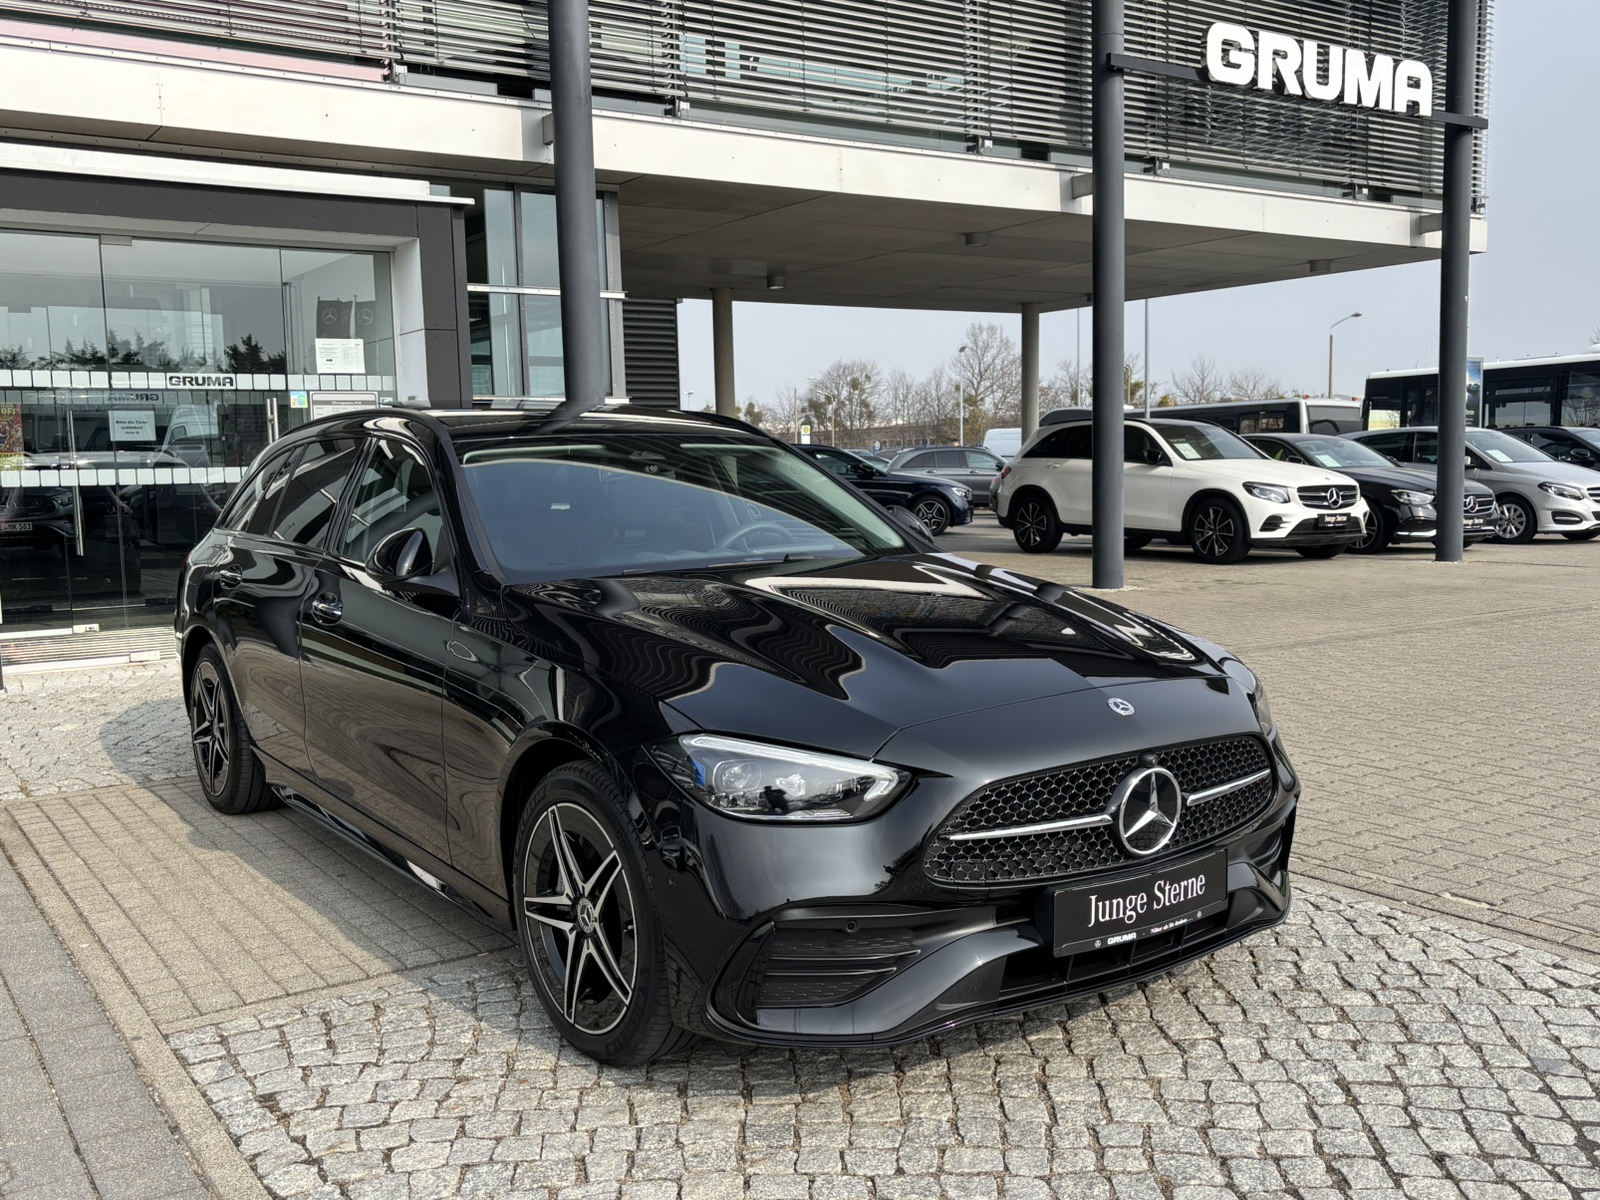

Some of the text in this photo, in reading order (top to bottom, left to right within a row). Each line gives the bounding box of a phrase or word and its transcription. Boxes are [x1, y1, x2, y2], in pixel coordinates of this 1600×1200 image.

[1206, 22, 1433, 117] GRUMA
[168, 376, 234, 387] GRUMA
[1088, 874, 1206, 927] Junge Sterne
[1107, 932, 1137, 946] GRUMA
